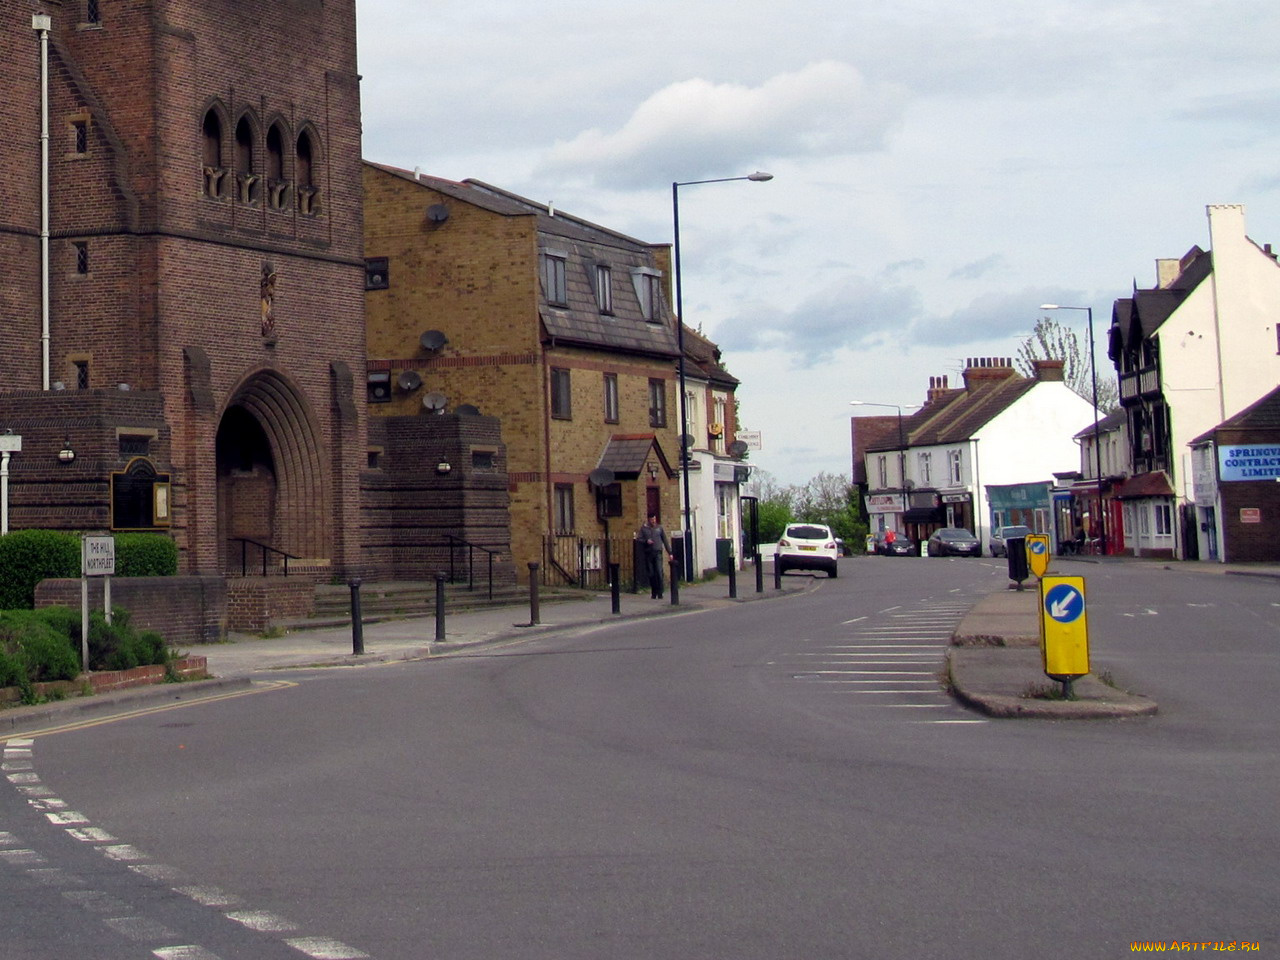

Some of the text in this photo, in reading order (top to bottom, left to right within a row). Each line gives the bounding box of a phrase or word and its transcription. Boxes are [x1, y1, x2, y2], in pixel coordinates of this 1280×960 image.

[91, 542, 110, 553] THE HILL
[87, 557, 113, 569] NORTHFLEET
